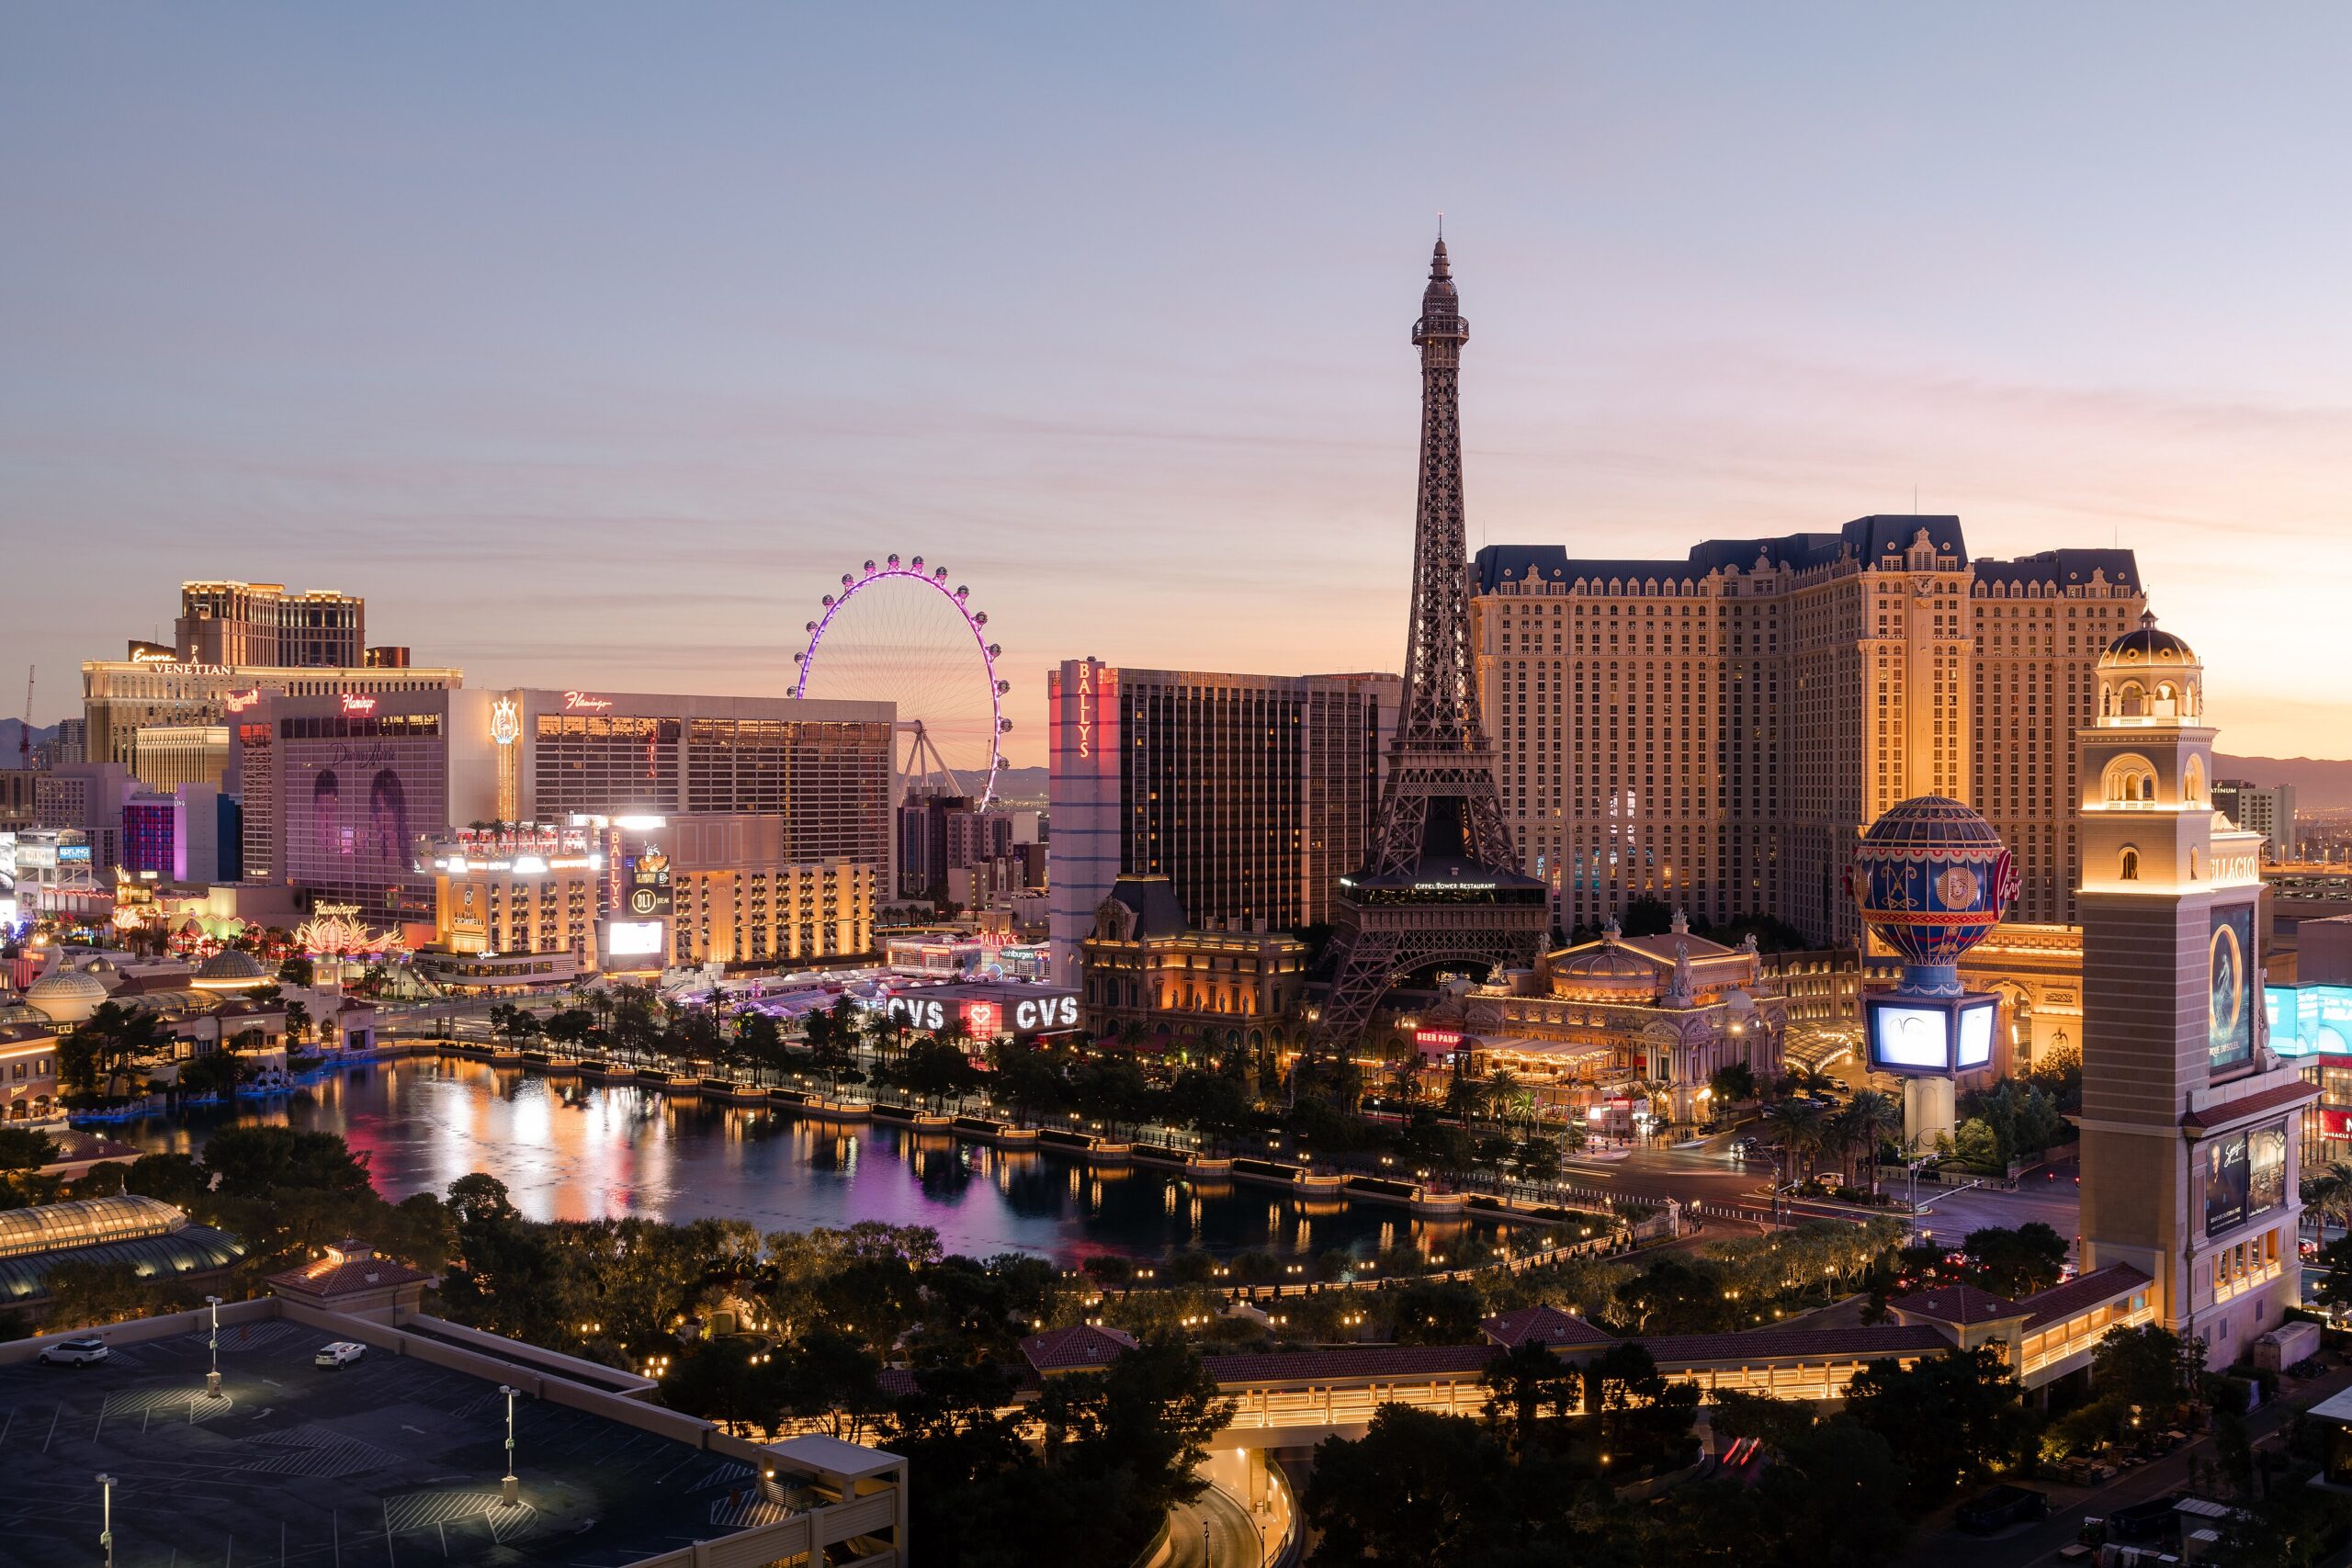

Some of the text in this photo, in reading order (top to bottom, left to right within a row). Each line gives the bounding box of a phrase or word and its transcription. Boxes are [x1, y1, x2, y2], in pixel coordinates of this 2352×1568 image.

[133, 648, 176, 662] Encore
[154, 662, 232, 675] VENETIAN
[342, 694, 375, 714] Flamingo
[564, 691, 613, 712] Flamingo
[1078, 662, 1091, 758] BALLYS
[610, 831, 621, 909] BALLYS
[2211, 855, 2256, 883] ELLAGIO
[314, 900, 362, 919] Flamingo
[638, 894, 651, 908] BLT
[888, 997, 1078, 1030] CVS CVS
[1417, 1032, 1459, 1043] BEER PARK
[2210, 1045, 2221, 1057] RQUE
